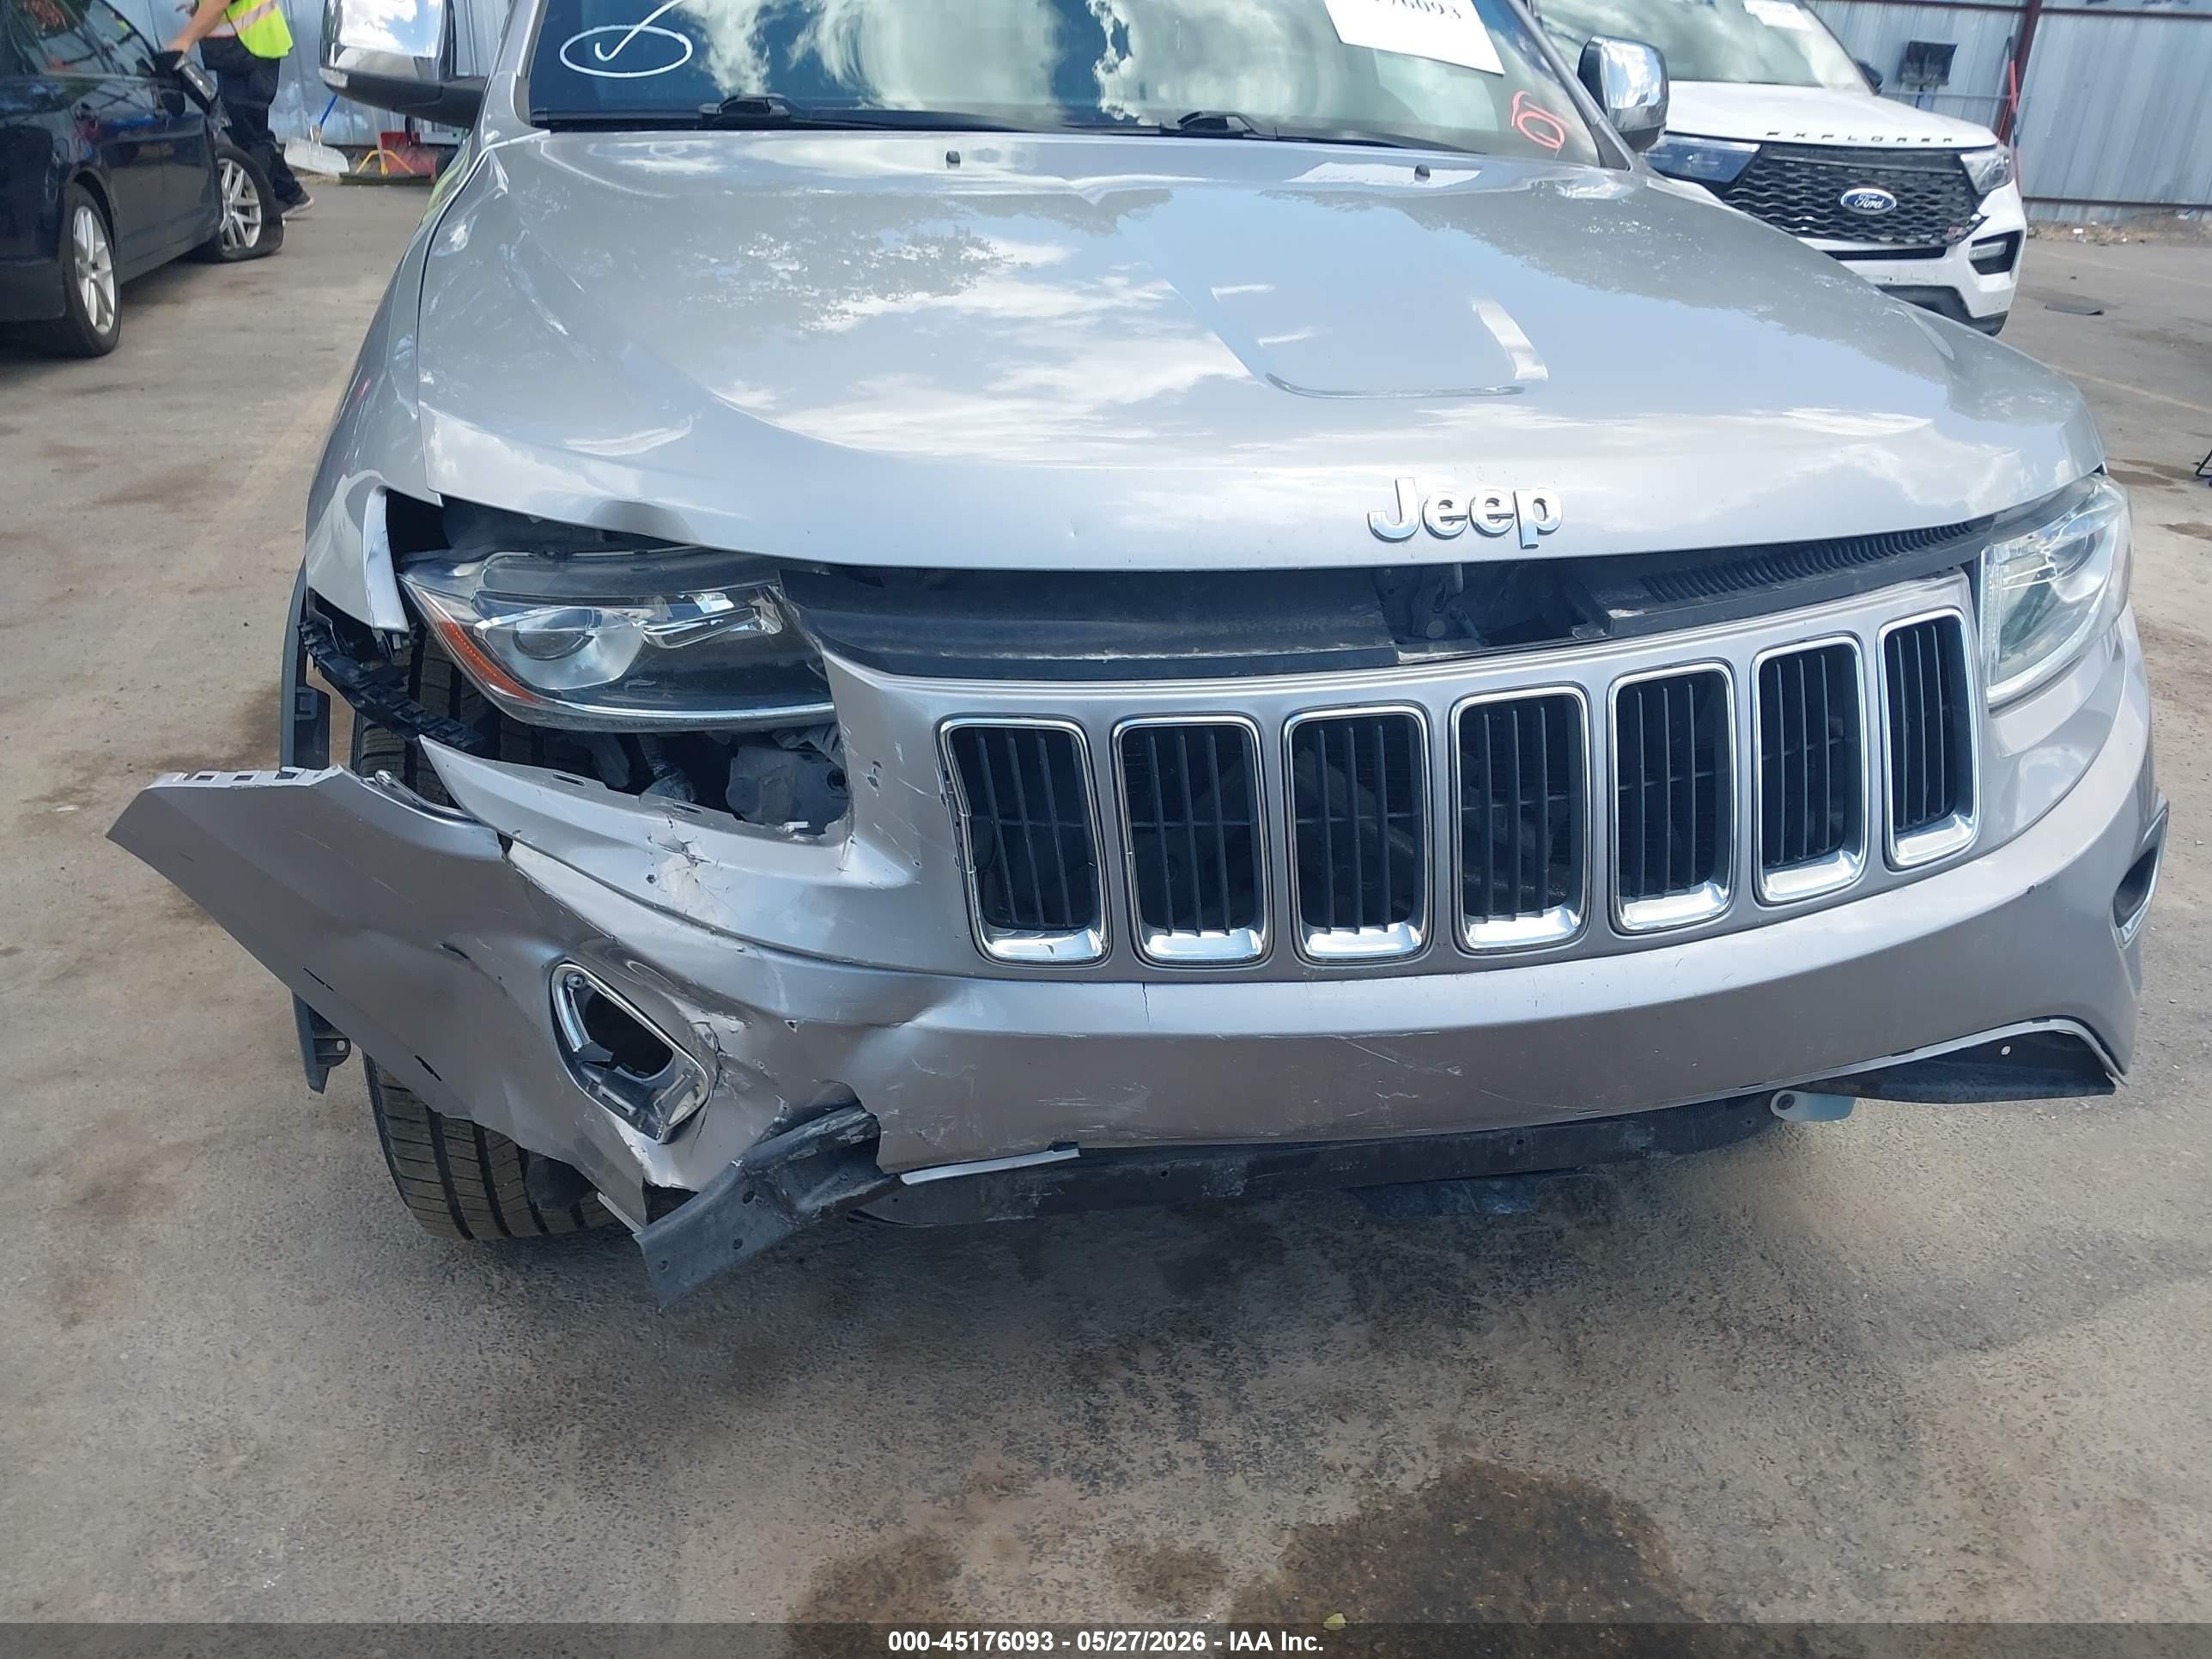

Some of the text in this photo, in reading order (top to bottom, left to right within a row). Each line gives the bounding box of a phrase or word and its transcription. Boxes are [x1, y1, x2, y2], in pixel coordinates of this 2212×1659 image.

[1765, 131, 1953, 143] EXPLORER
[1855, 192, 1886, 210] Ford
[1367, 477, 1563, 550] Jeep
